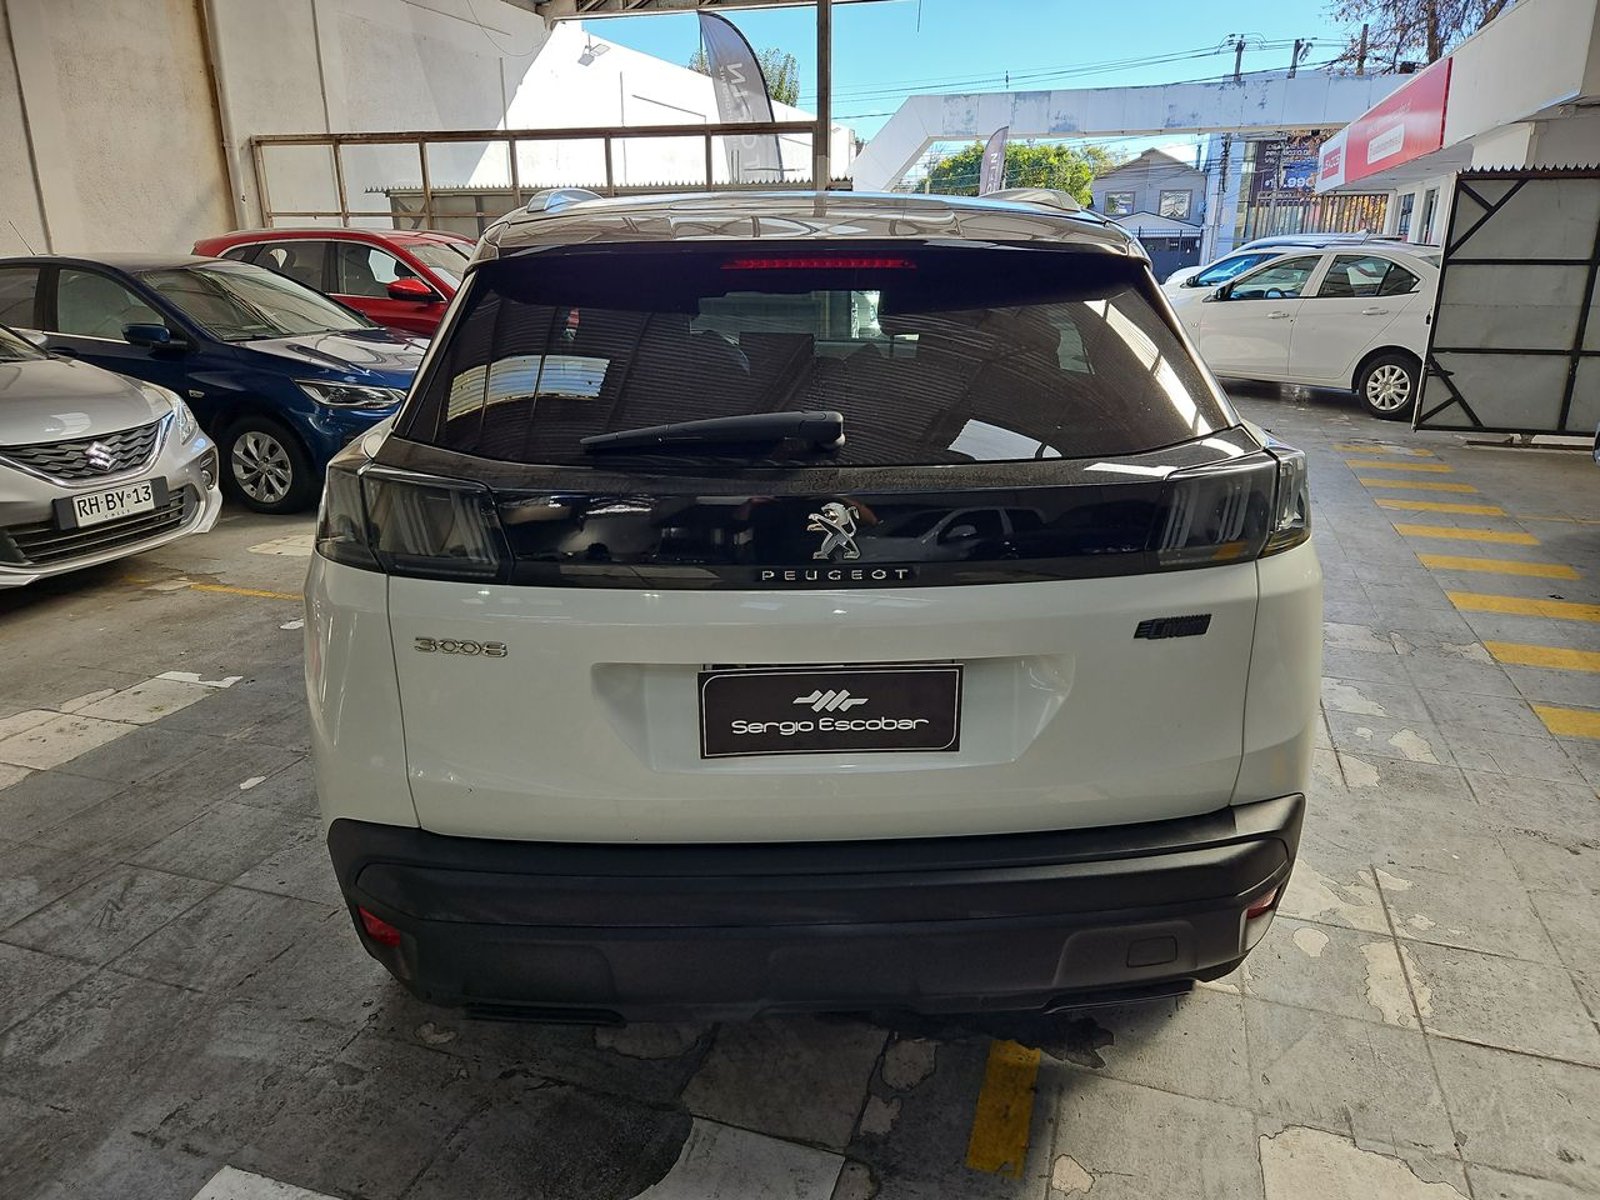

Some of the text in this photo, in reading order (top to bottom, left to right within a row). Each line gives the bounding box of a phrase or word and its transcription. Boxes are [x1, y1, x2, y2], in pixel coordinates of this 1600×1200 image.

[761, 569, 908, 581] PEUGEOT
[414, 636, 509, 658] 3008
[731, 716, 930, 736] Sergio Escobar
